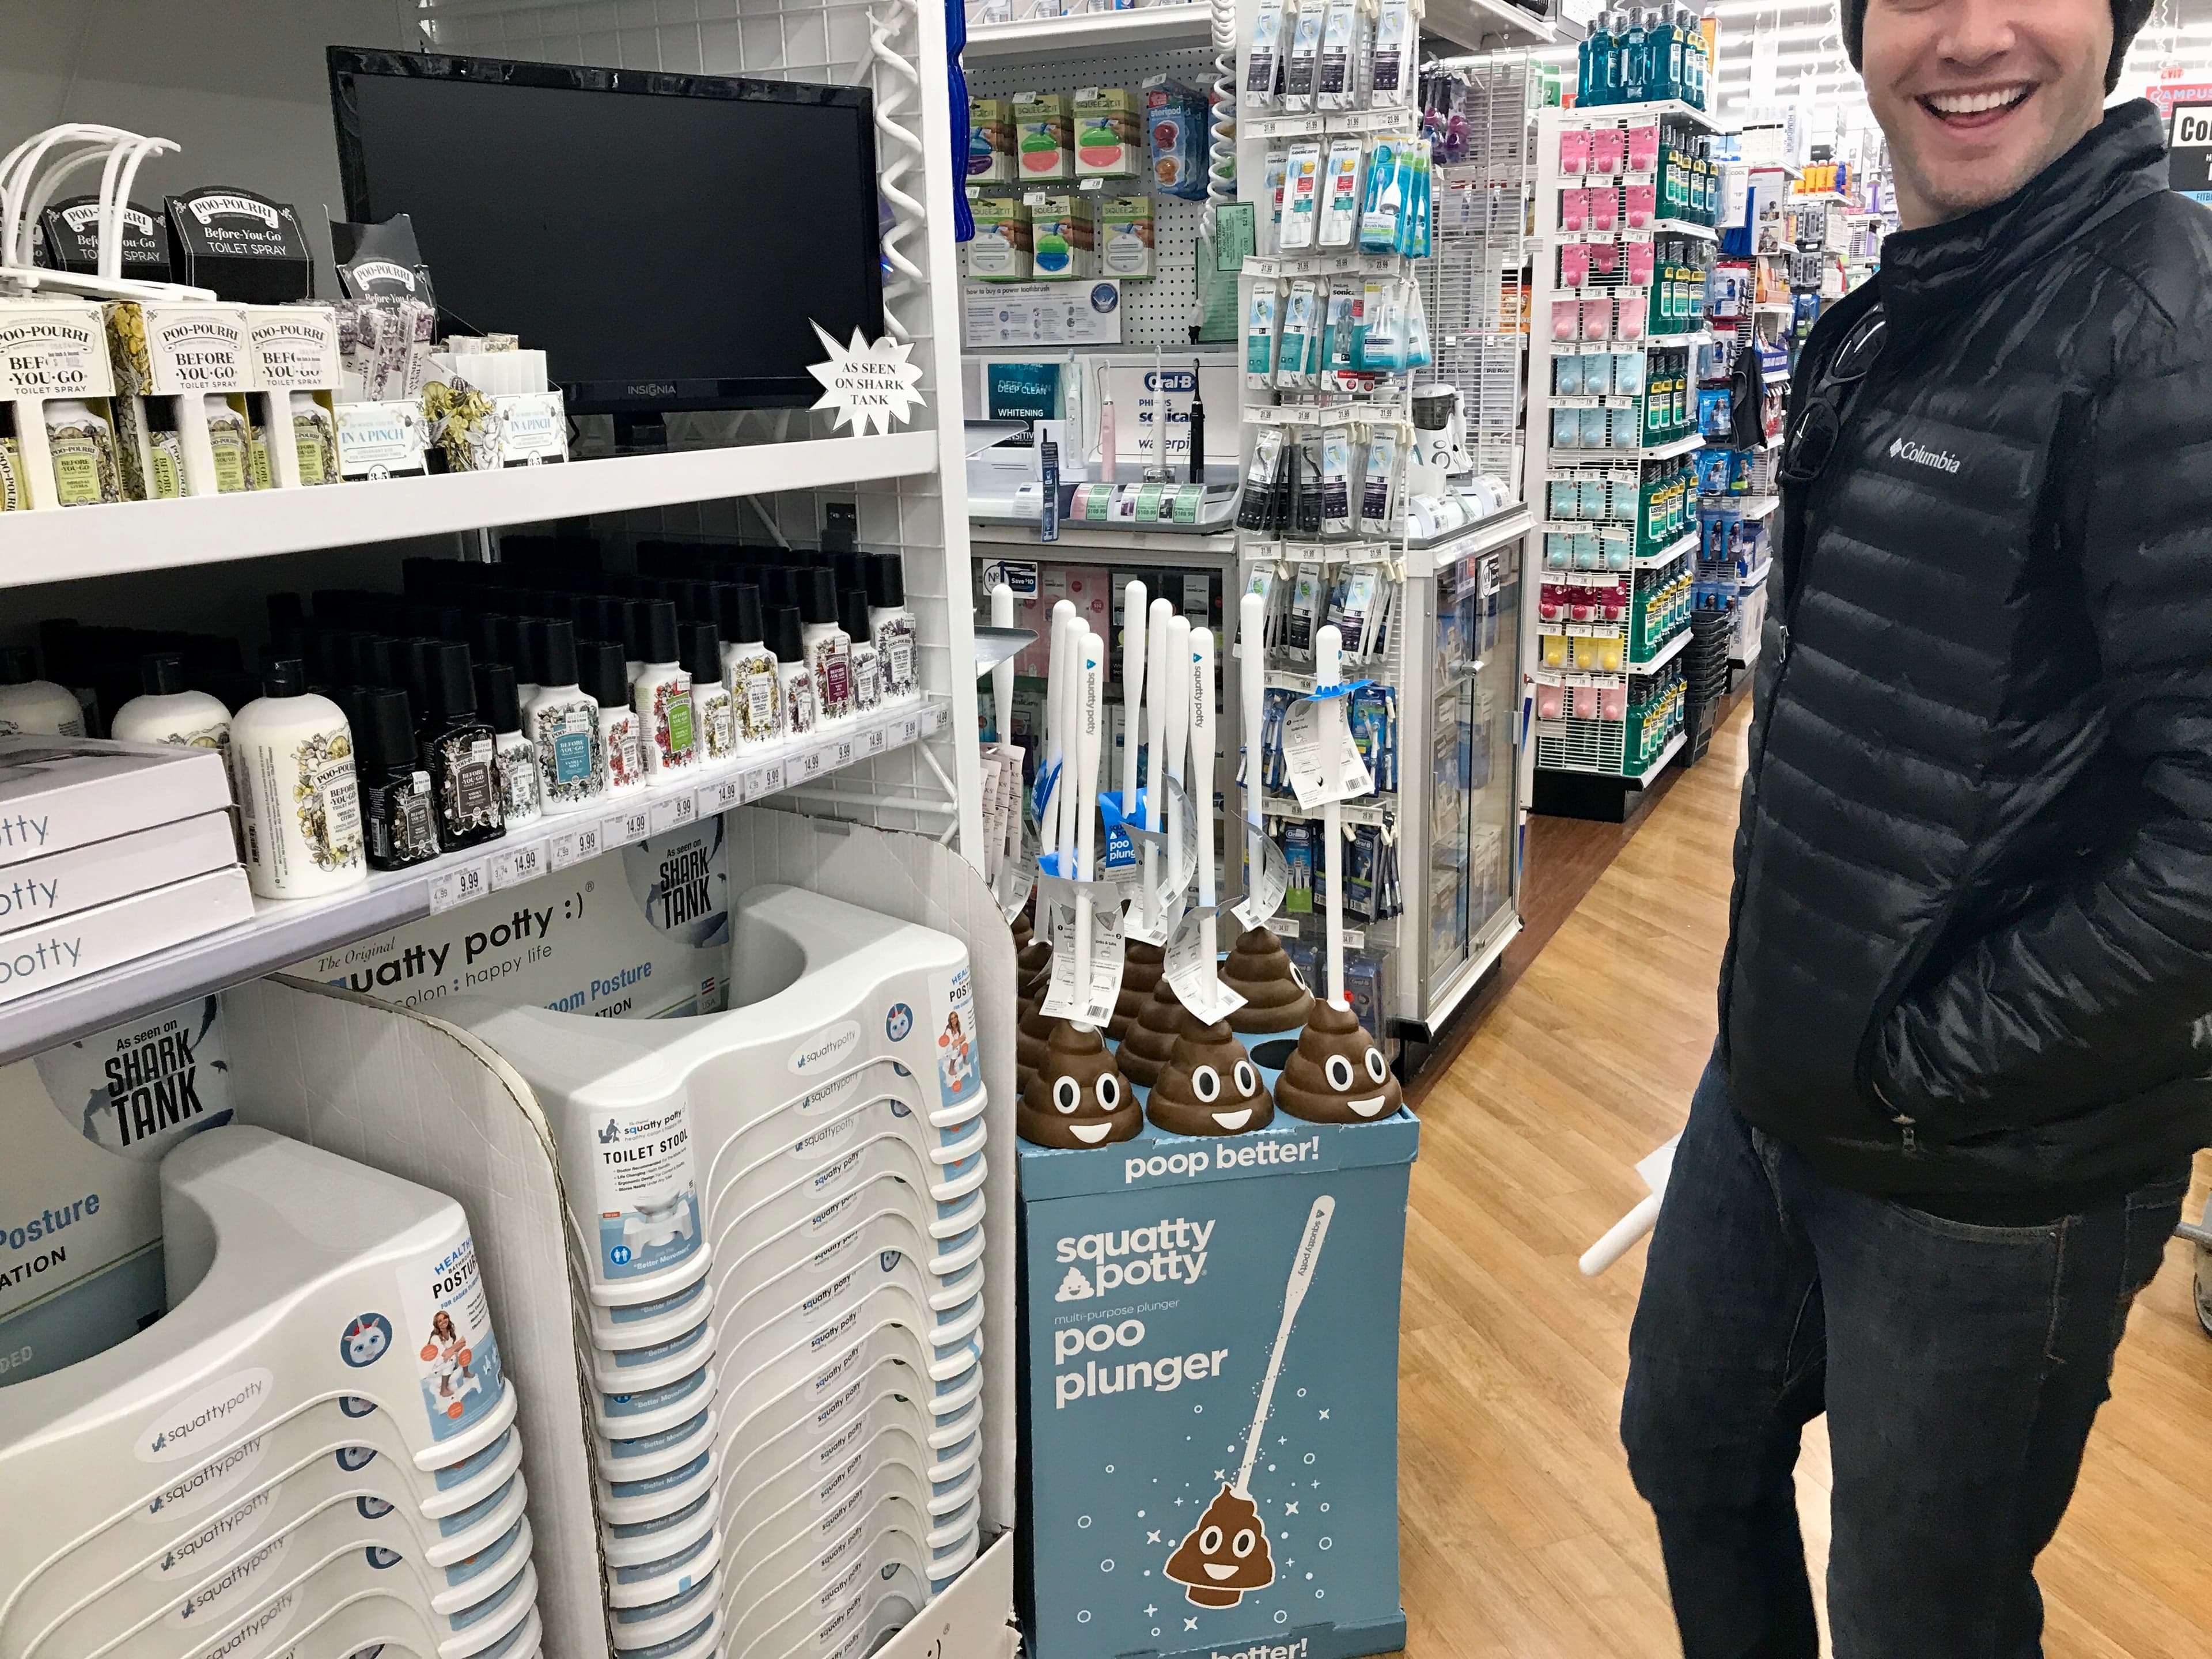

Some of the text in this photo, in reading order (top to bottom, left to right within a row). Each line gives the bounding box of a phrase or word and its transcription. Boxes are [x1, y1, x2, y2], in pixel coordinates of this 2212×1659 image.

[194, 198, 272, 219] POO-POURRI
[204, 227, 281, 242] Before-You-Go
[207, 242, 286, 256] TOILET SPRAY
[357, 264, 410, 282] POO-POURRI
[162, 323, 239, 342] POO-POURRI
[251, 324, 325, 341] POO-POURRI
[175, 351, 235, 366] BEFORE
[842, 363, 896, 375] AS SEEN
[14, 387, 51, 395] TOILET
[627, 384, 677, 396] INSIGNIA
[835, 378, 905, 391] ON SHARK
[850, 393, 889, 406] TANK
[998, 408, 1044, 417] WHITENING
[342, 428, 405, 444] IN A PINCH
[1900, 441, 1961, 473] Columbia
[1193, 665, 1204, 729] squatty potty
[1086, 709, 1094, 736] potty
[559, 740, 584, 748] BEFORE
[869, 732, 883, 747] 14.99
[839, 744, 851, 759] 9.99
[462, 768, 485, 779] BEFORE
[804, 755, 819, 772] 14.99
[766, 769, 779, 786] 9.99
[330, 782, 355, 798] BEFORE
[718, 784, 735, 802] 14.99
[677, 799, 691, 817] 9.99
[626, 815, 645, 835] 14.99
[579, 832, 596, 852] 9.99
[667, 839, 702, 858] As seen on
[1109, 840, 1130, 851] poo
[494, 867, 508, 878] 3.74
[514, 851, 536, 873] 14.99
[658, 847, 709, 893] SHARK
[460, 871, 479, 892] 9.99
[661, 876, 713, 930] TANK
[465, 904, 554, 965] potty
[317, 937, 396, 974] The Original
[465, 956, 522, 987] happy
[527, 944, 552, 965] life
[590, 961, 653, 1002] Posture
[700, 998, 716, 1010] USA
[115, 1018, 179, 1052] As seen on
[104, 1028, 196, 1099] SHARK
[110, 1065, 204, 1148] TANK
[624, 1120, 662, 1134] squatty
[664, 1109, 682, 1124] potty
[603, 1144, 654, 1165] TOILET
[660, 1128, 688, 1153] STOOL
[624, 1132, 646, 1142] healthy
[815, 1151, 859, 1187] squatty potty
[1124, 1135, 1320, 1184] poop better!
[1055, 1217, 1216, 1266] squatty
[1297, 1218, 1321, 1277] squatty potty
[1096, 1249, 1208, 1297] potty
[441, 1300, 452, 1310] FOR
[802, 1287, 832, 1310] squatty
[1054, 1298, 1180, 1327] multi-purpose plunger
[811, 1311, 857, 1347] squatty potty
[1054, 1318, 1145, 1365] poo
[815, 1346, 859, 1389] squatty potty
[1055, 1347, 1228, 1410] plunger
[817, 1381, 861, 1422] squatty potty
[820, 1421, 862, 1461] squatty potty
[820, 1472, 846, 1499] squatty
[821, 1505, 847, 1531] squatty
[821, 1525, 862, 1567] squatty potty
[820, 1578, 848, 1604] squatty
[820, 1614, 845, 1639] squatty
